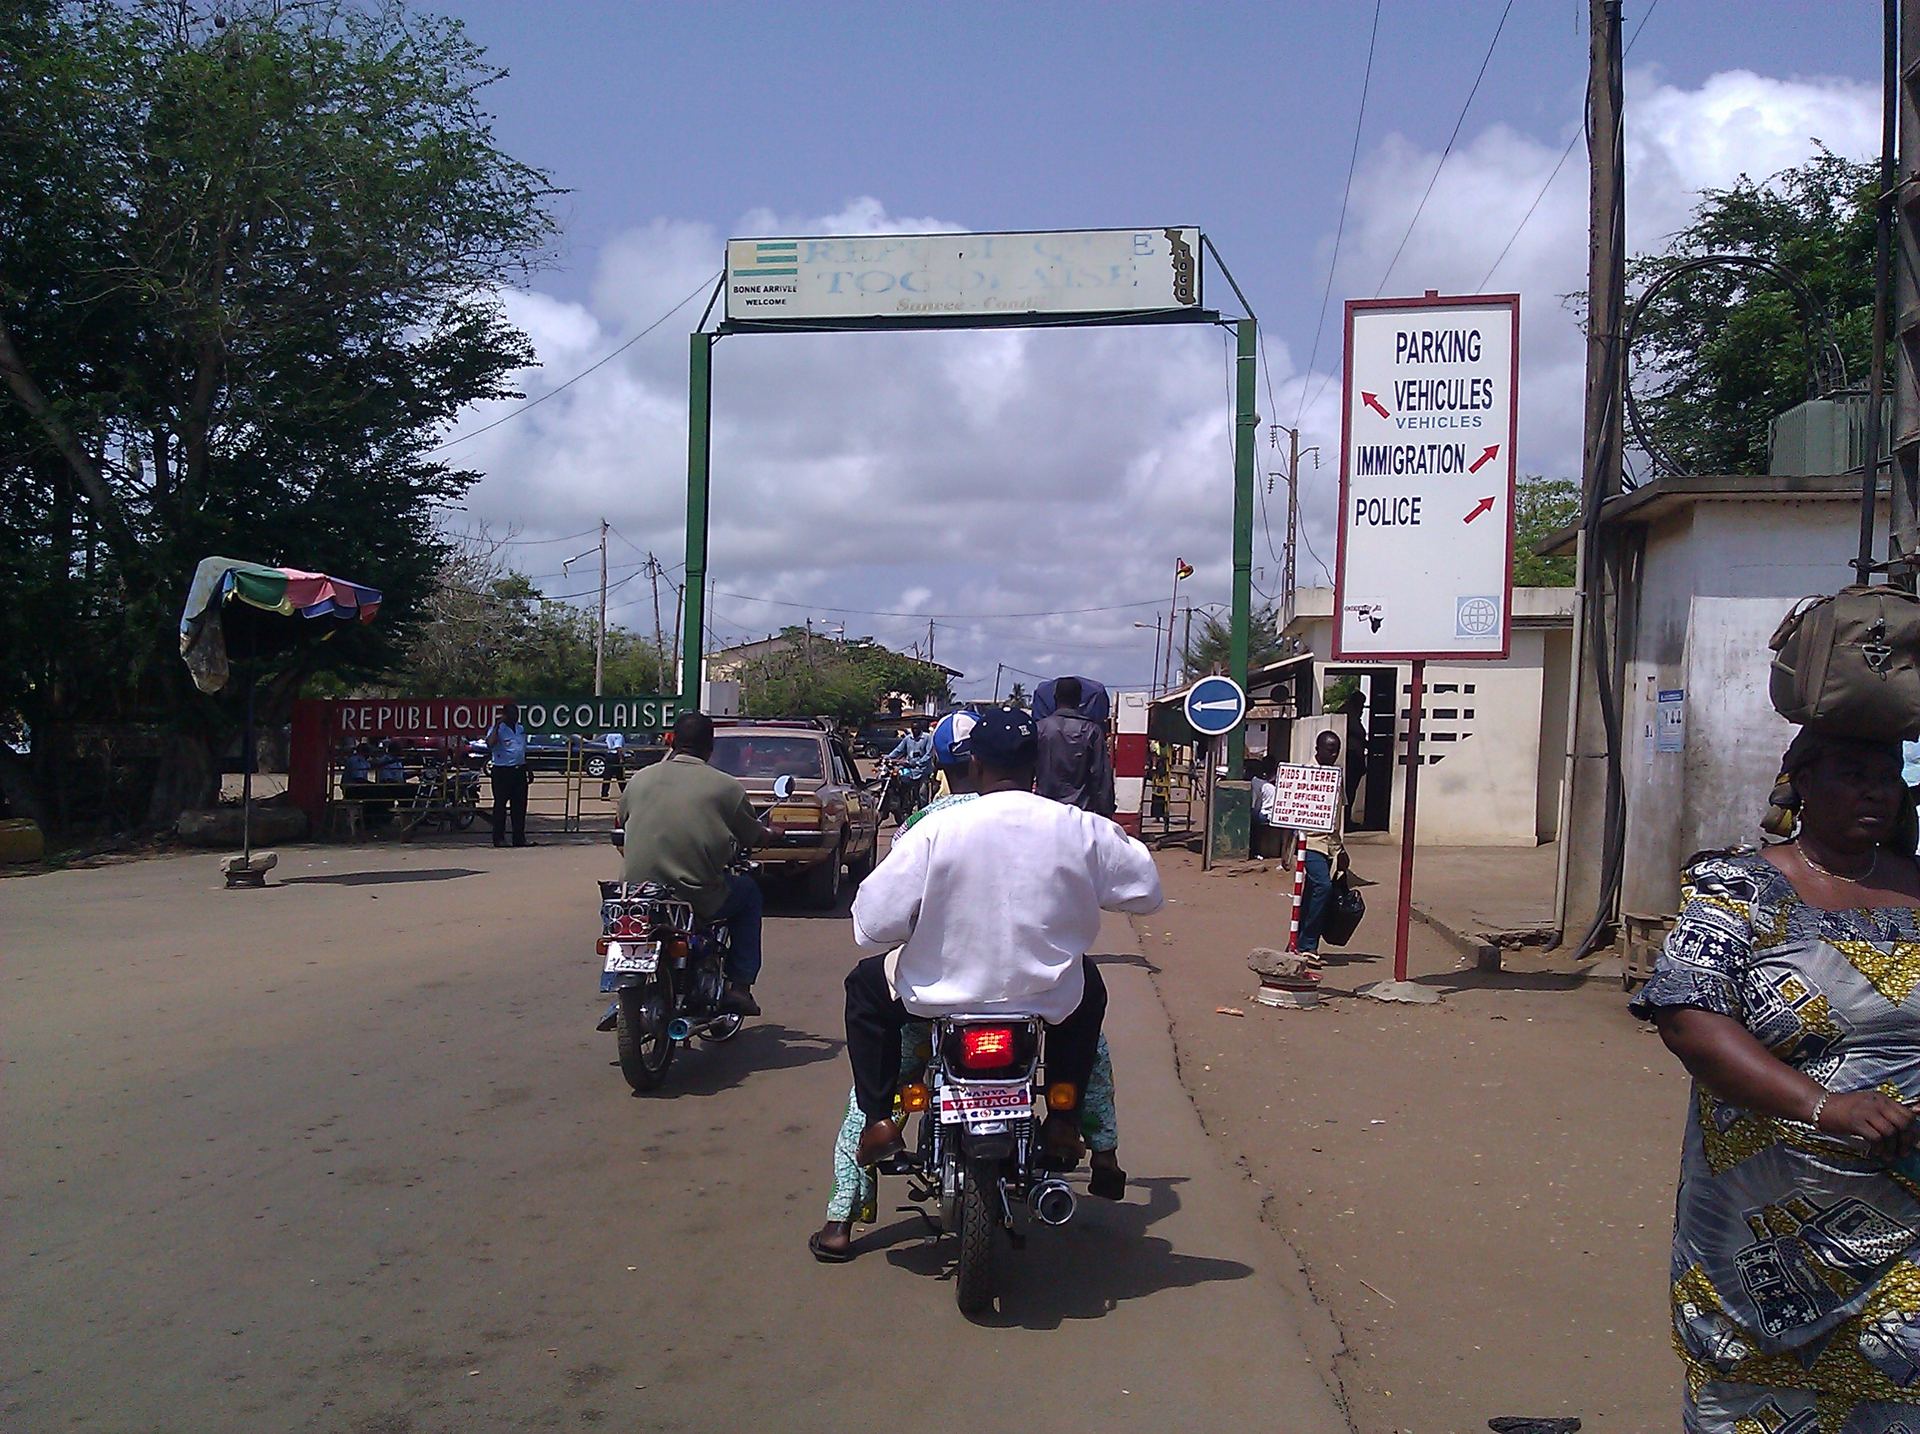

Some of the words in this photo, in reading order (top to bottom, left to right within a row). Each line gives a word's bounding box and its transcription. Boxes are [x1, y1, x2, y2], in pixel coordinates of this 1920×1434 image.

[1175, 249, 1187, 297] TOGO
[733, 285, 761, 294] BONNE
[745, 298, 787, 306] WELCOME
[1395, 329, 1482, 364] PARKING
[1394, 378, 1494, 412] VEHICULES
[1395, 416, 1482, 429] VEHICLES
[1356, 443, 1466, 476] IMMIGRATION
[1355, 497, 1422, 526] POLICE
[517, 703, 675, 728] TOGOLAISE
[1280, 768, 1300, 780] PIEDS
[1310, 770, 1337, 783] TERRE
[1279, 781, 1293, 790] SAUF
[1296, 782, 1335, 793] DIPLOMATES
[1284, 791, 1292, 799] ET
[1294, 792, 1326, 803] OFFICIELS
[1275, 808, 1296, 816] EXCEPT
[1297, 809, 1331, 819] DIPLOMATS
[1294, 817, 1325, 826] OFFICIALS
